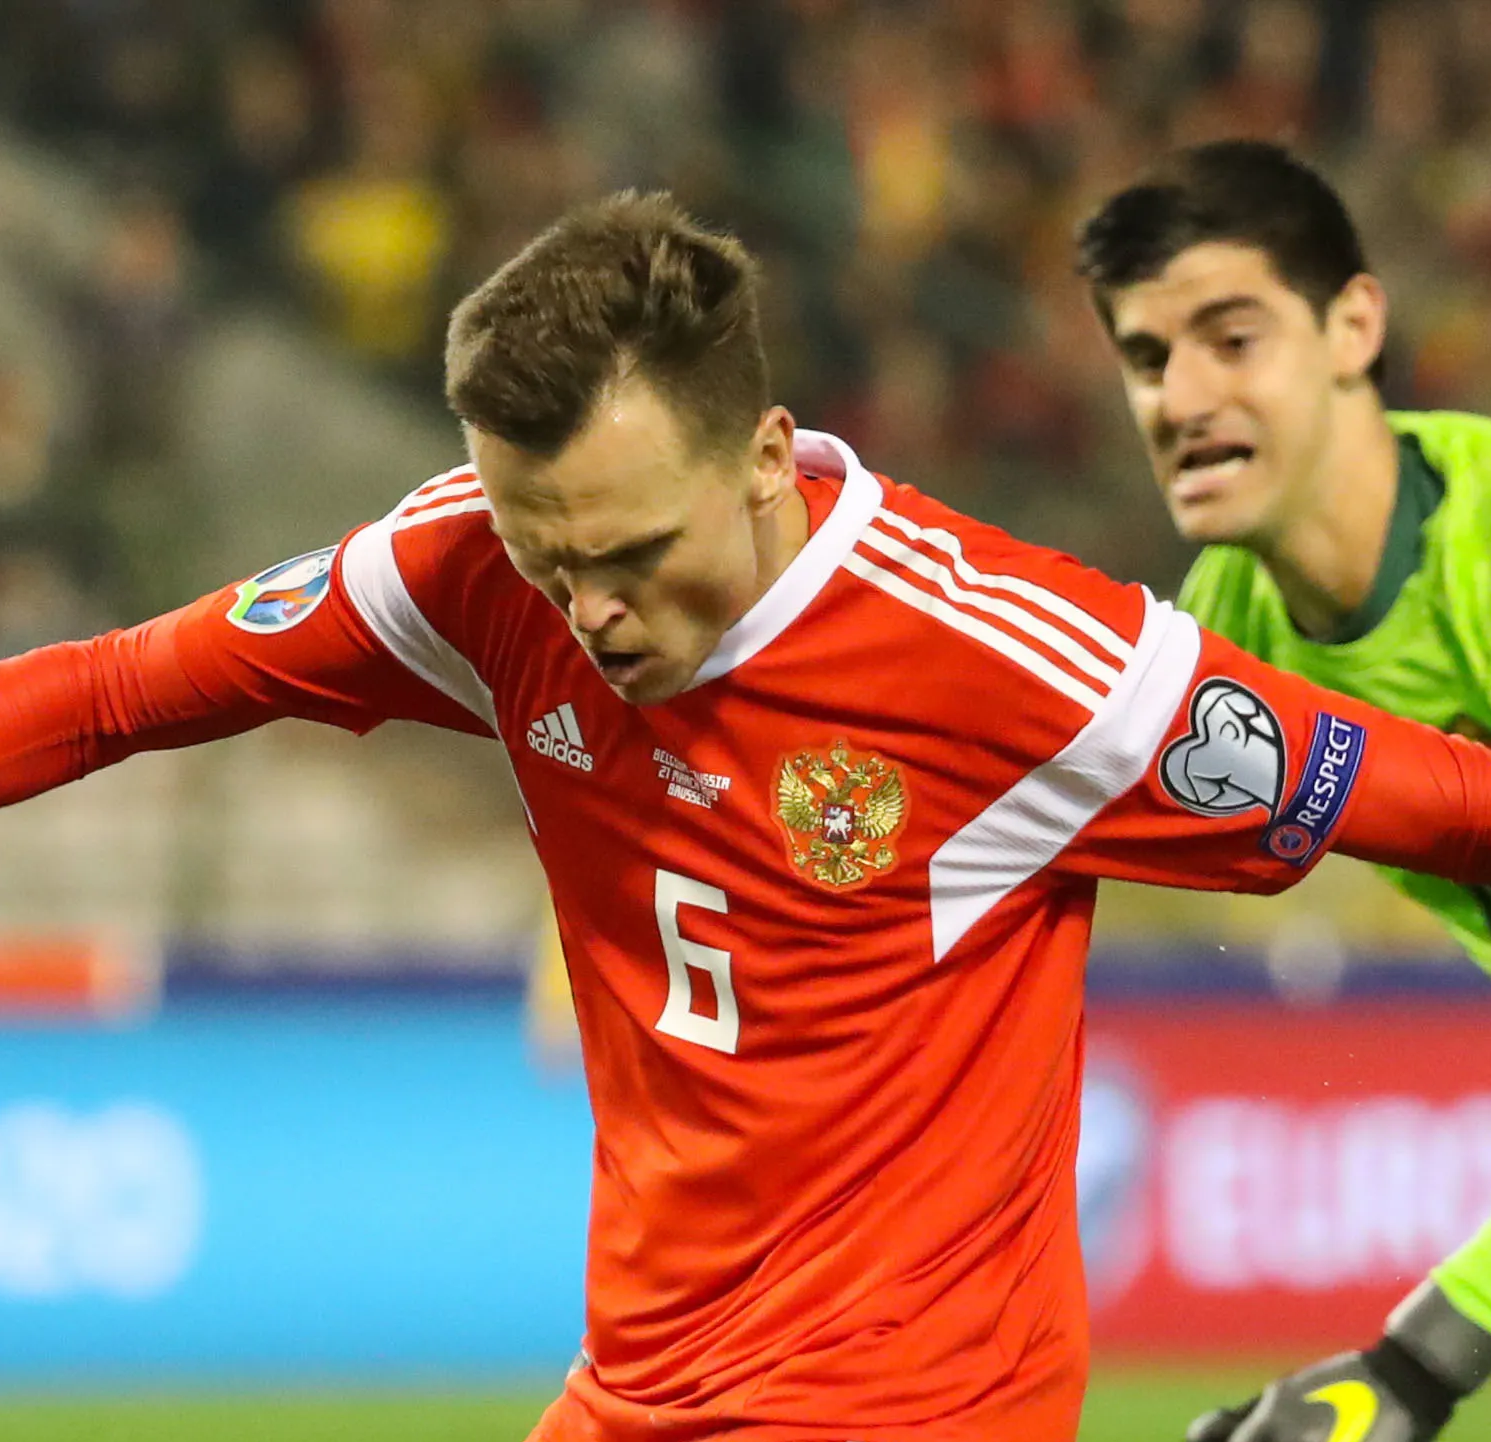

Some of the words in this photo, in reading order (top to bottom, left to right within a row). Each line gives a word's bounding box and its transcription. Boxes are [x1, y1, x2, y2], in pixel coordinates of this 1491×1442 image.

[526, 729, 594, 772] adidas
[1296, 716, 1353, 828] RESPECT
[654, 868, 740, 1054] 6
